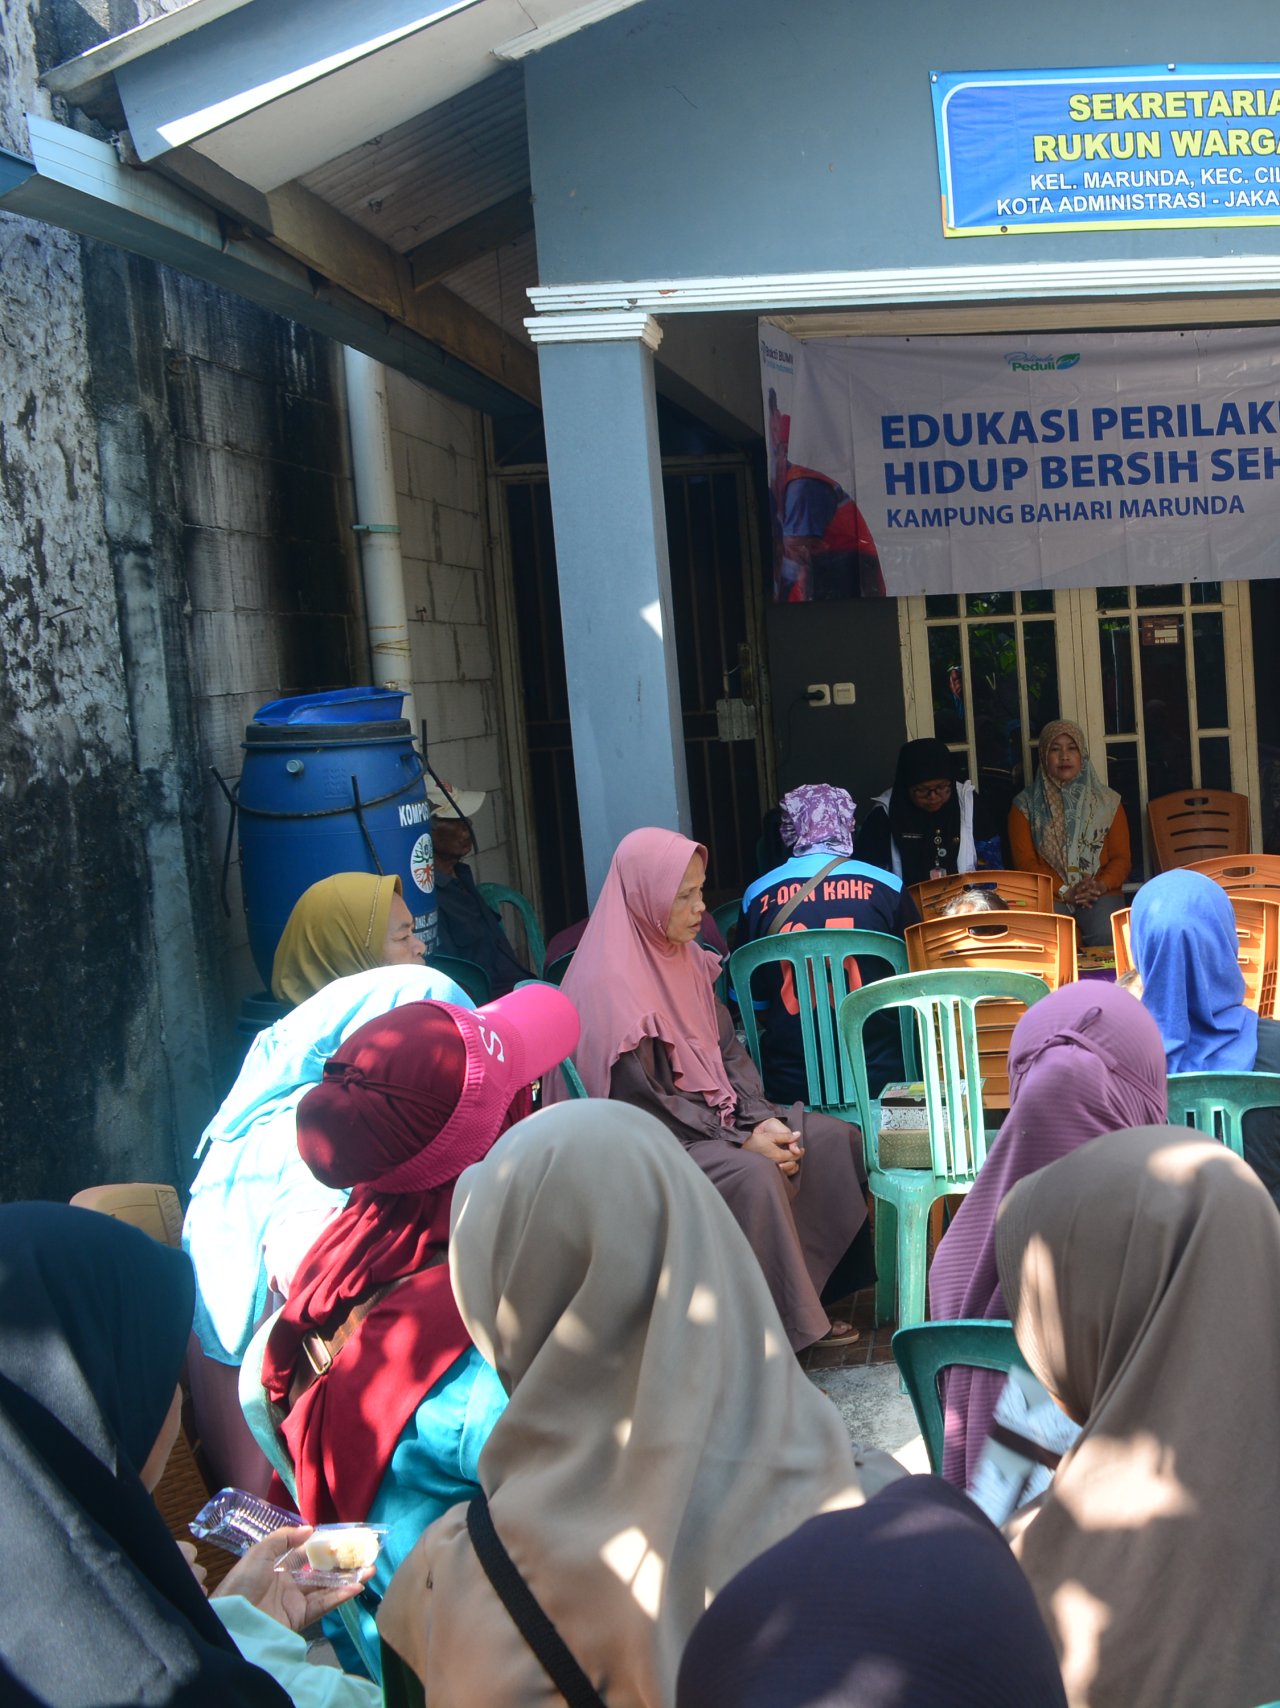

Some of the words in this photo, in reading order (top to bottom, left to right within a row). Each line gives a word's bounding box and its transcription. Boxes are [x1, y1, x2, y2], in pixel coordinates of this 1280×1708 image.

[1033, 130, 1161, 163] RUKUN
[1030, 172, 1077, 191] KEL.
[1083, 169, 1196, 189] MARUNDA,
[1200, 167, 1249, 185] KEC.
[996, 196, 1055, 216] KOTA
[1058, 191, 1207, 214] ADMINISTRASI
[1012, 361, 1055, 371] Peduli
[880, 407, 1080, 449] EDUKASI
[884, 457, 1029, 496] HIDUP
[1041, 450, 1199, 489] BERSIH
[887, 504, 1014, 528] KAMPUNG
[1020, 500, 1113, 524] BAHARI
[1120, 495, 1244, 518] MARUNDA
[823, 879, 874, 901] KAHF
